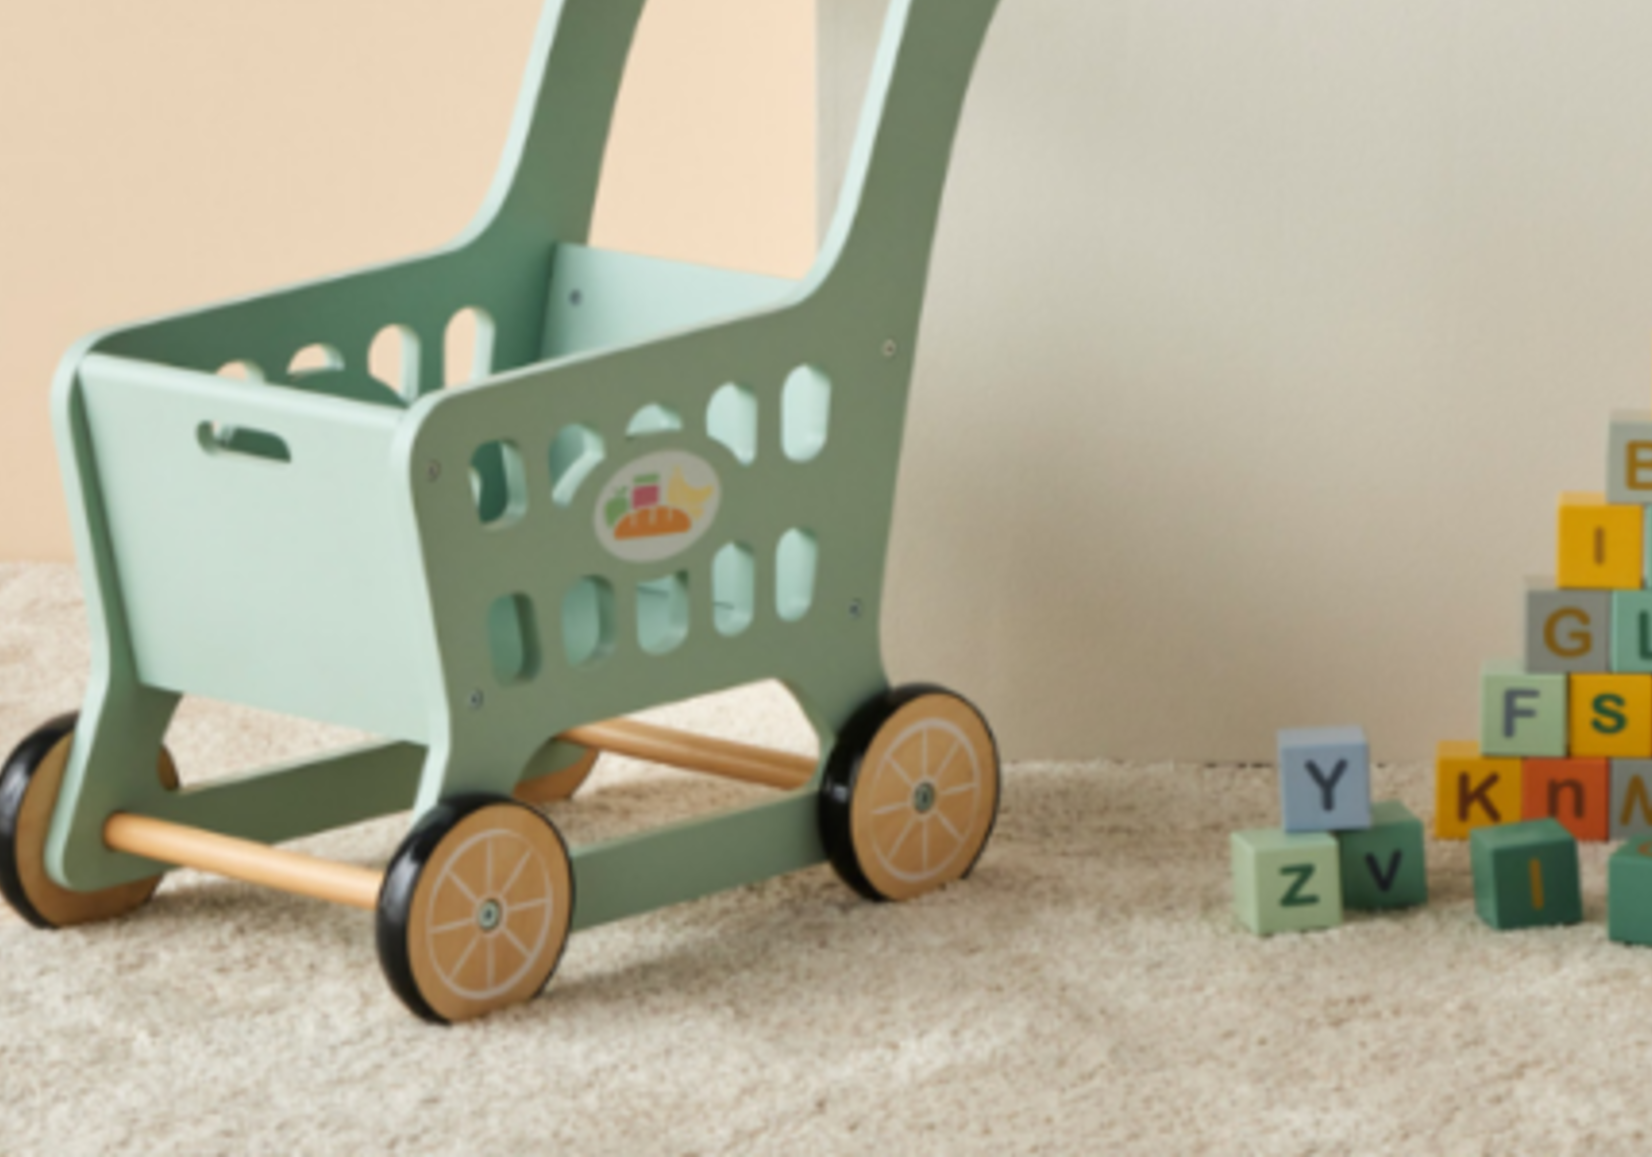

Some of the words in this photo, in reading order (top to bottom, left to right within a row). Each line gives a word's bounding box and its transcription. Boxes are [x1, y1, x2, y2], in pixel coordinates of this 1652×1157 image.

[1543, 607, 1593, 659] G
[1503, 688, 1541, 739] F
[1304, 758, 1348, 813] Y
[1457, 771, 1502, 823] K
[1547, 778, 1585, 820] n
